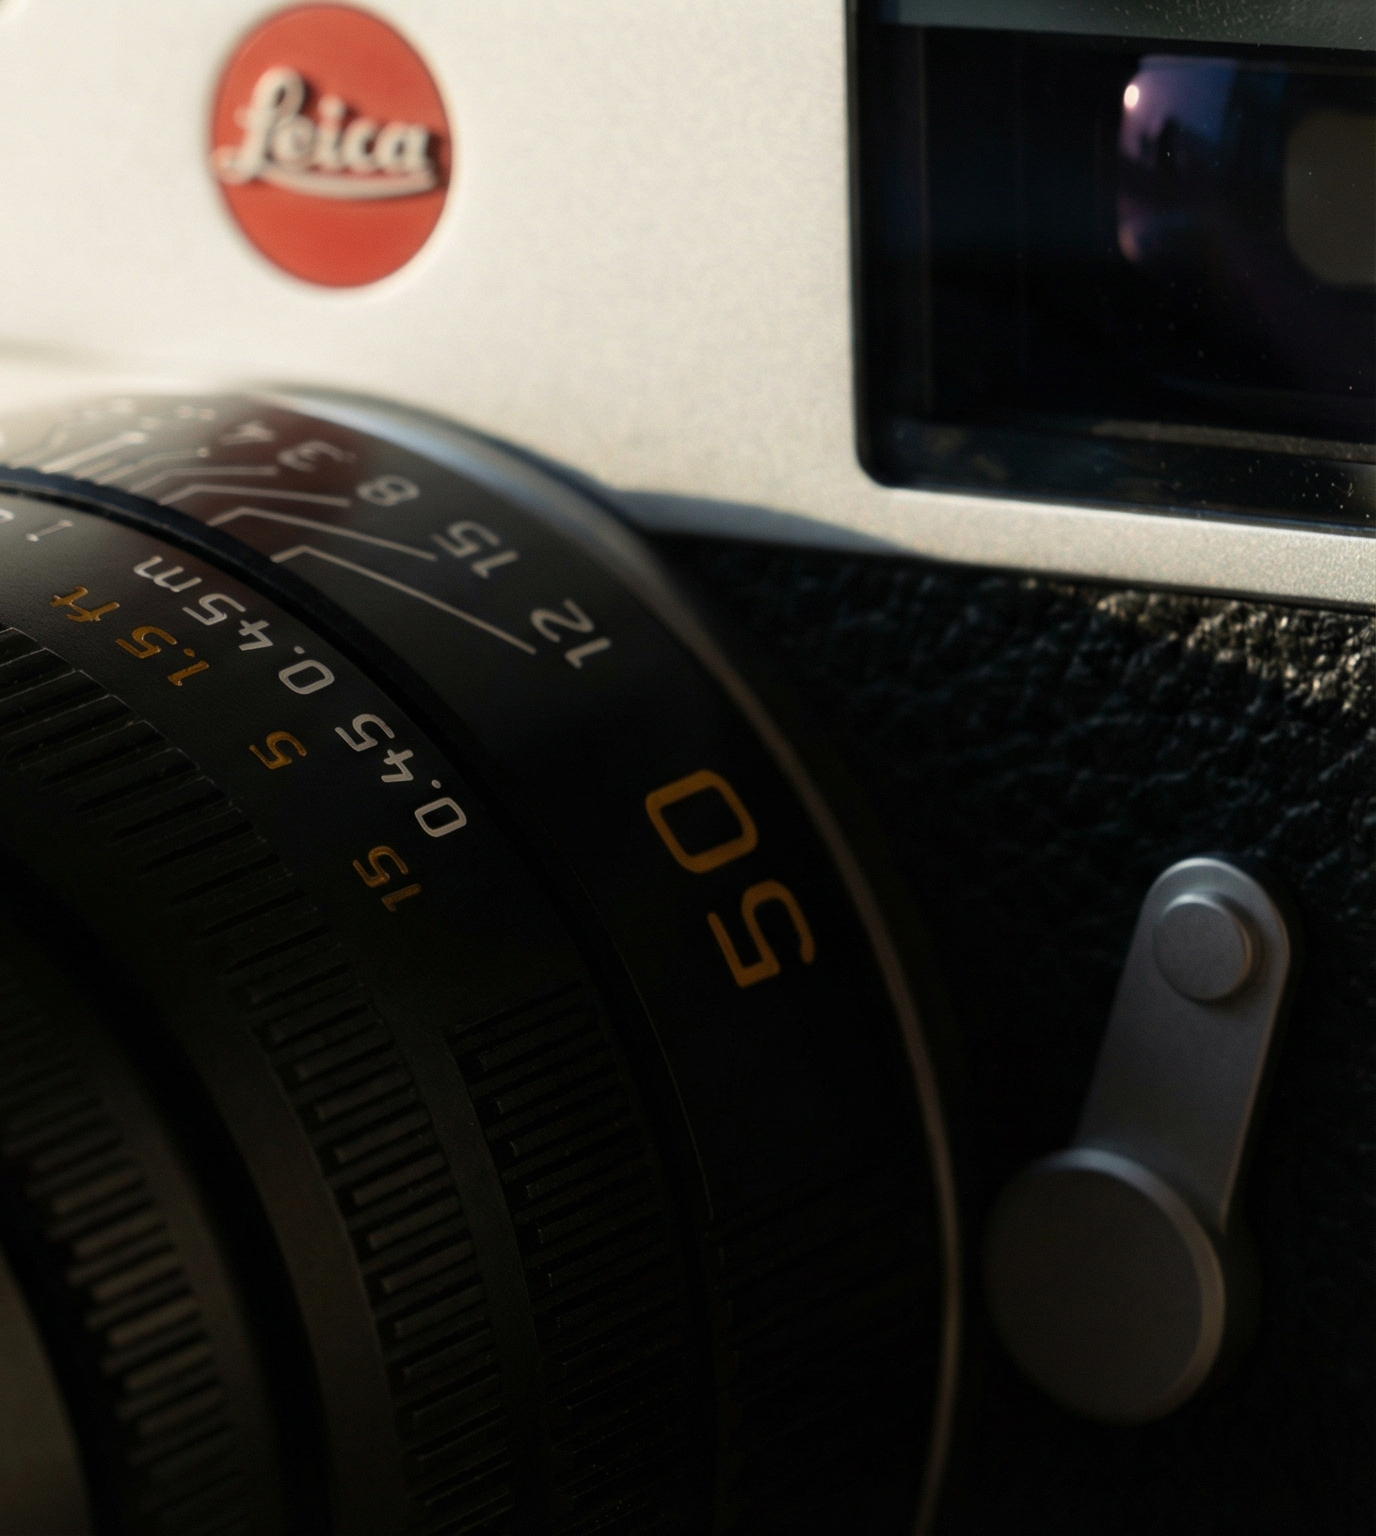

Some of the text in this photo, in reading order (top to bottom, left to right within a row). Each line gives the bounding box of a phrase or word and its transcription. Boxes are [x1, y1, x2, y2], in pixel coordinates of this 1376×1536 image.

[212, 66, 438, 200] Leica
[356, 474, 420, 507] 8
[432, 520, 519, 579] 15
[115, 625, 210, 688] 1.5
[530, 600, 612, 669] 12
[249, 730, 307, 770] 5
[334, 712, 467, 838] 0.45
[352, 845, 423, 912] 15
[644, 768, 816, 990] 50
